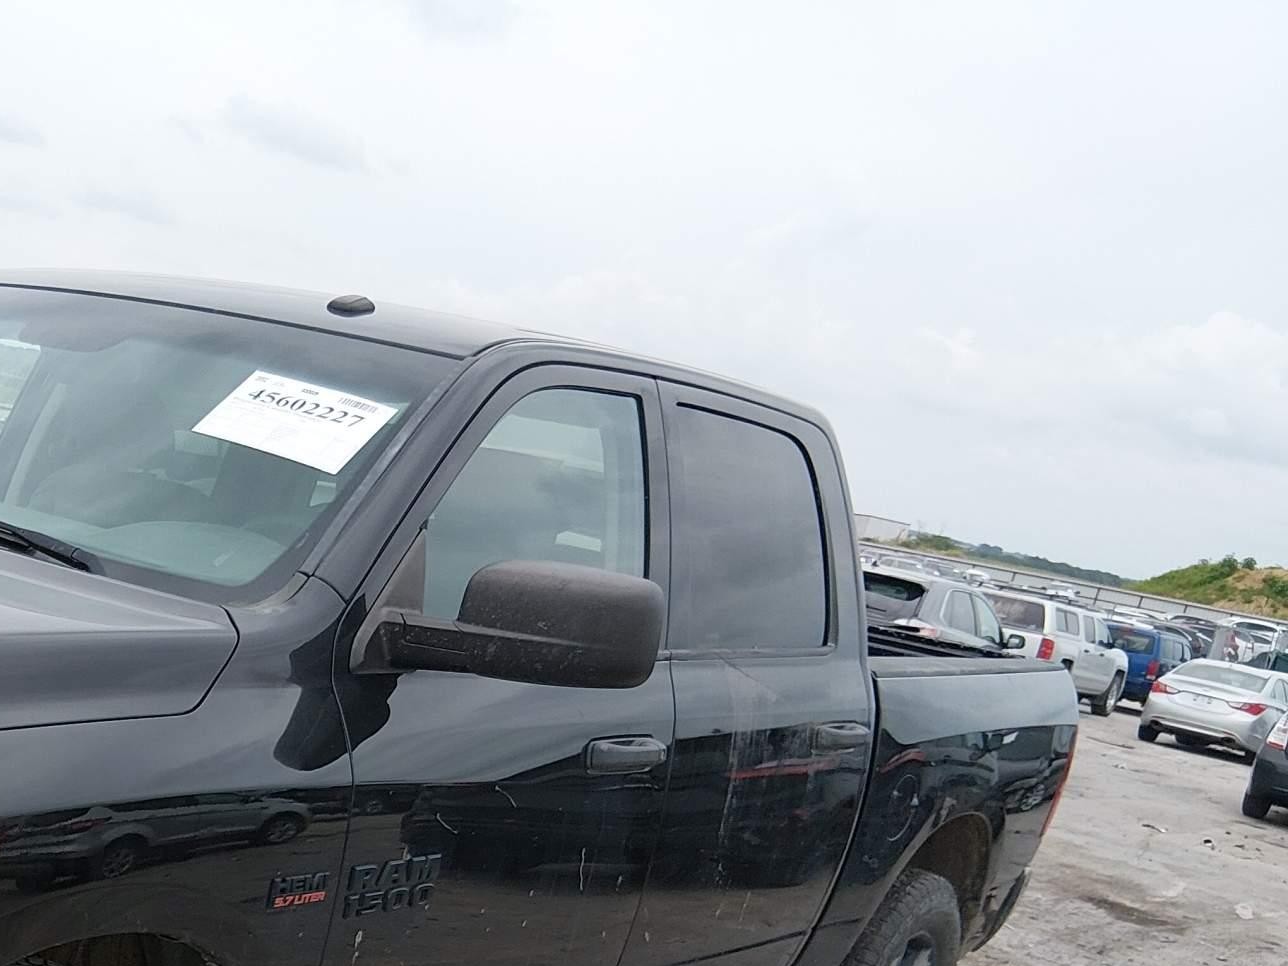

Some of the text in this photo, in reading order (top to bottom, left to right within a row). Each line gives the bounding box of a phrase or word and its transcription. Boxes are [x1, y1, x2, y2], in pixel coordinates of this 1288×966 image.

[248, 388, 365, 427] 45602227
[271, 872, 330, 895] HEMI
[347, 853, 442, 891] RAM
[272, 891, 326, 908] 5.7 LITER
[343, 882, 436, 919] 1500
